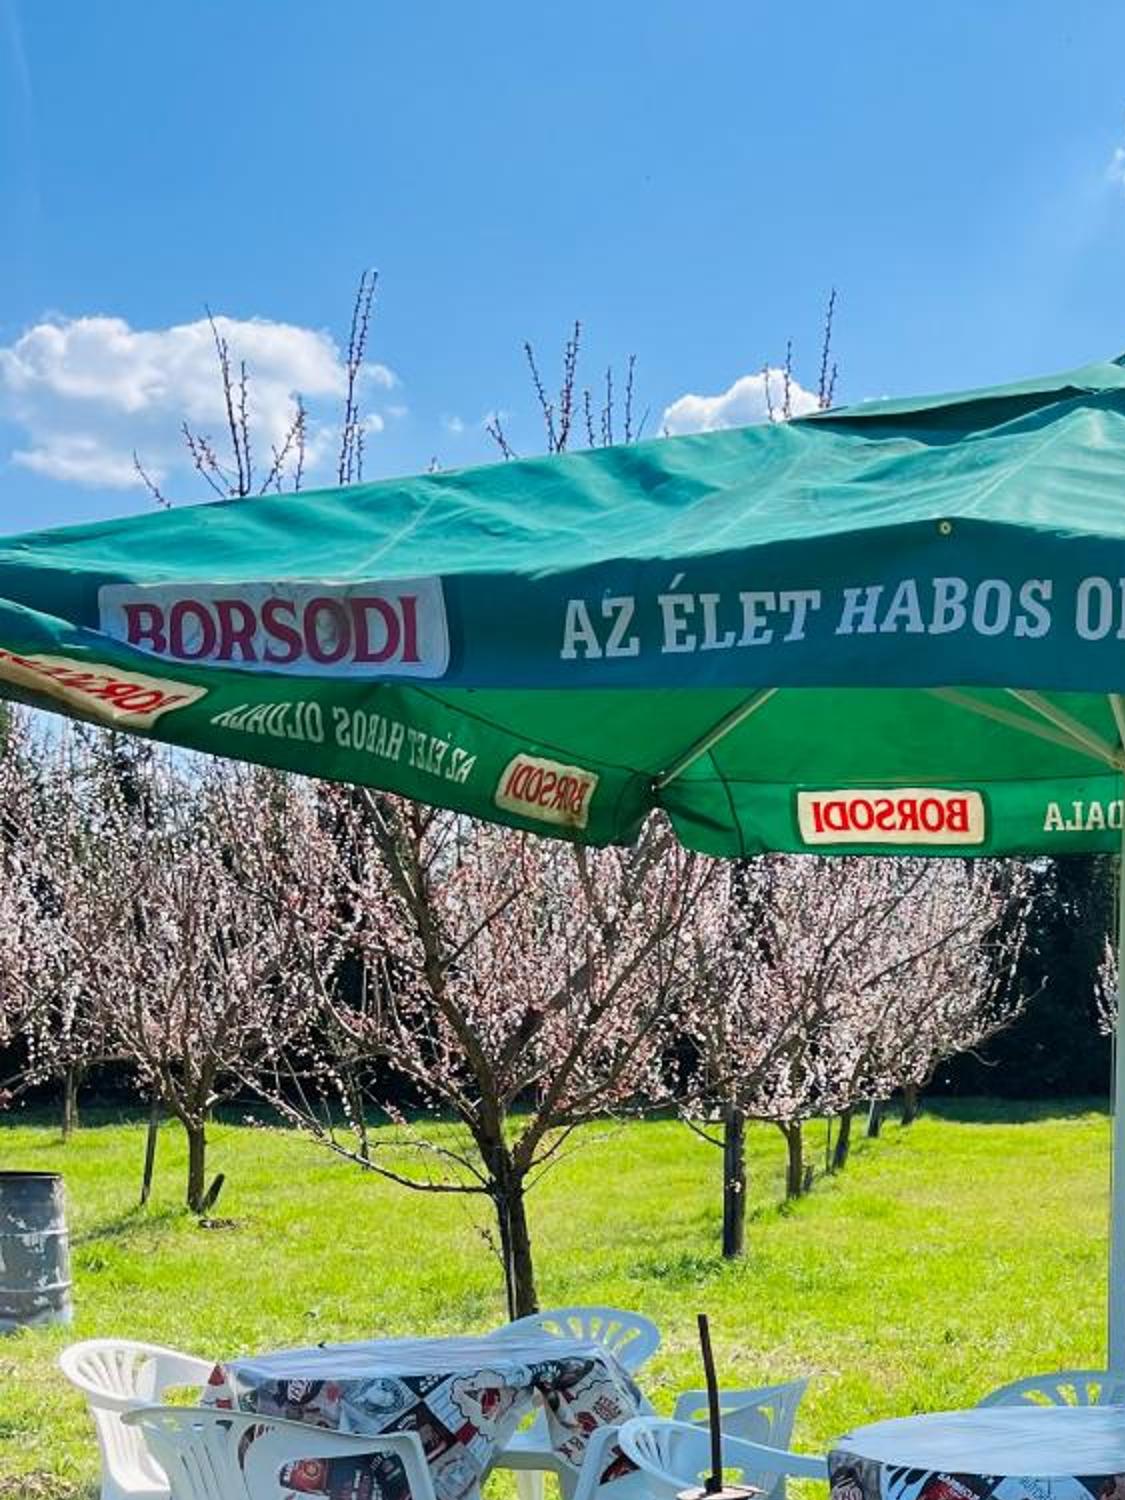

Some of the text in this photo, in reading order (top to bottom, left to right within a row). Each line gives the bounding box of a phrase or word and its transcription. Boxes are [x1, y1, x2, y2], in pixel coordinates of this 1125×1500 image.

[123, 596, 421, 664] BORSODI
[560, 597, 640, 659] AZ
[657, 573, 822, 654] ÉLET
[835, 576, 1053, 639] HABOS
